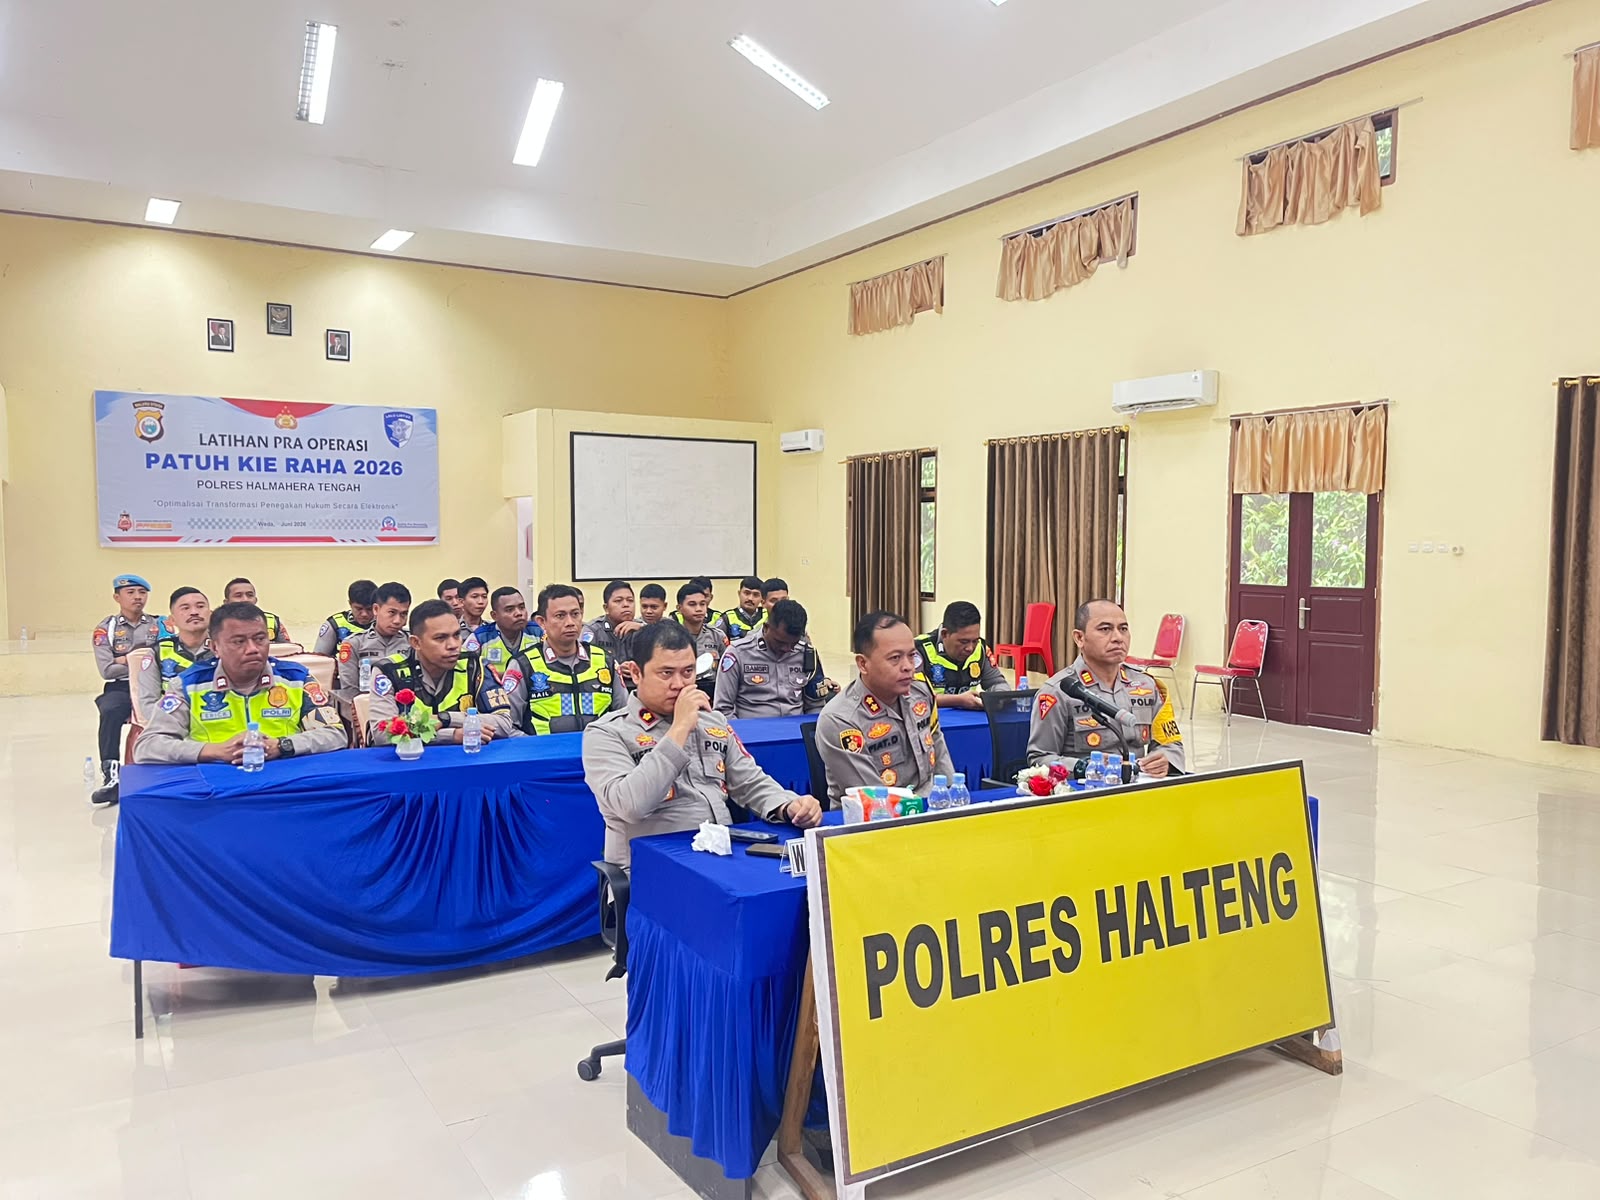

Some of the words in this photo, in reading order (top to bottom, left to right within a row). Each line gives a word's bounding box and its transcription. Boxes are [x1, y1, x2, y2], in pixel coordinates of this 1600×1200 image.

[199, 433, 269, 448] LATIHAN
[273, 436, 304, 450] PRA
[307, 438, 368, 452] OPERASI
[145, 453, 229, 472] PATUH
[237, 456, 278, 474] KIE
[285, 457, 347, 475] RAHA
[353, 460, 403, 476] 2026
[196, 480, 243, 490] POLRES
[246, 481, 315, 492] HALMAHERA
[317, 483, 361, 492] TENGAH
[206, 500, 258, 508] Transformasi
[260, 501, 303, 510] Penegakan
[863, 896, 1082, 1020] POLRES
[1095, 852, 1298, 963] HALTENG
